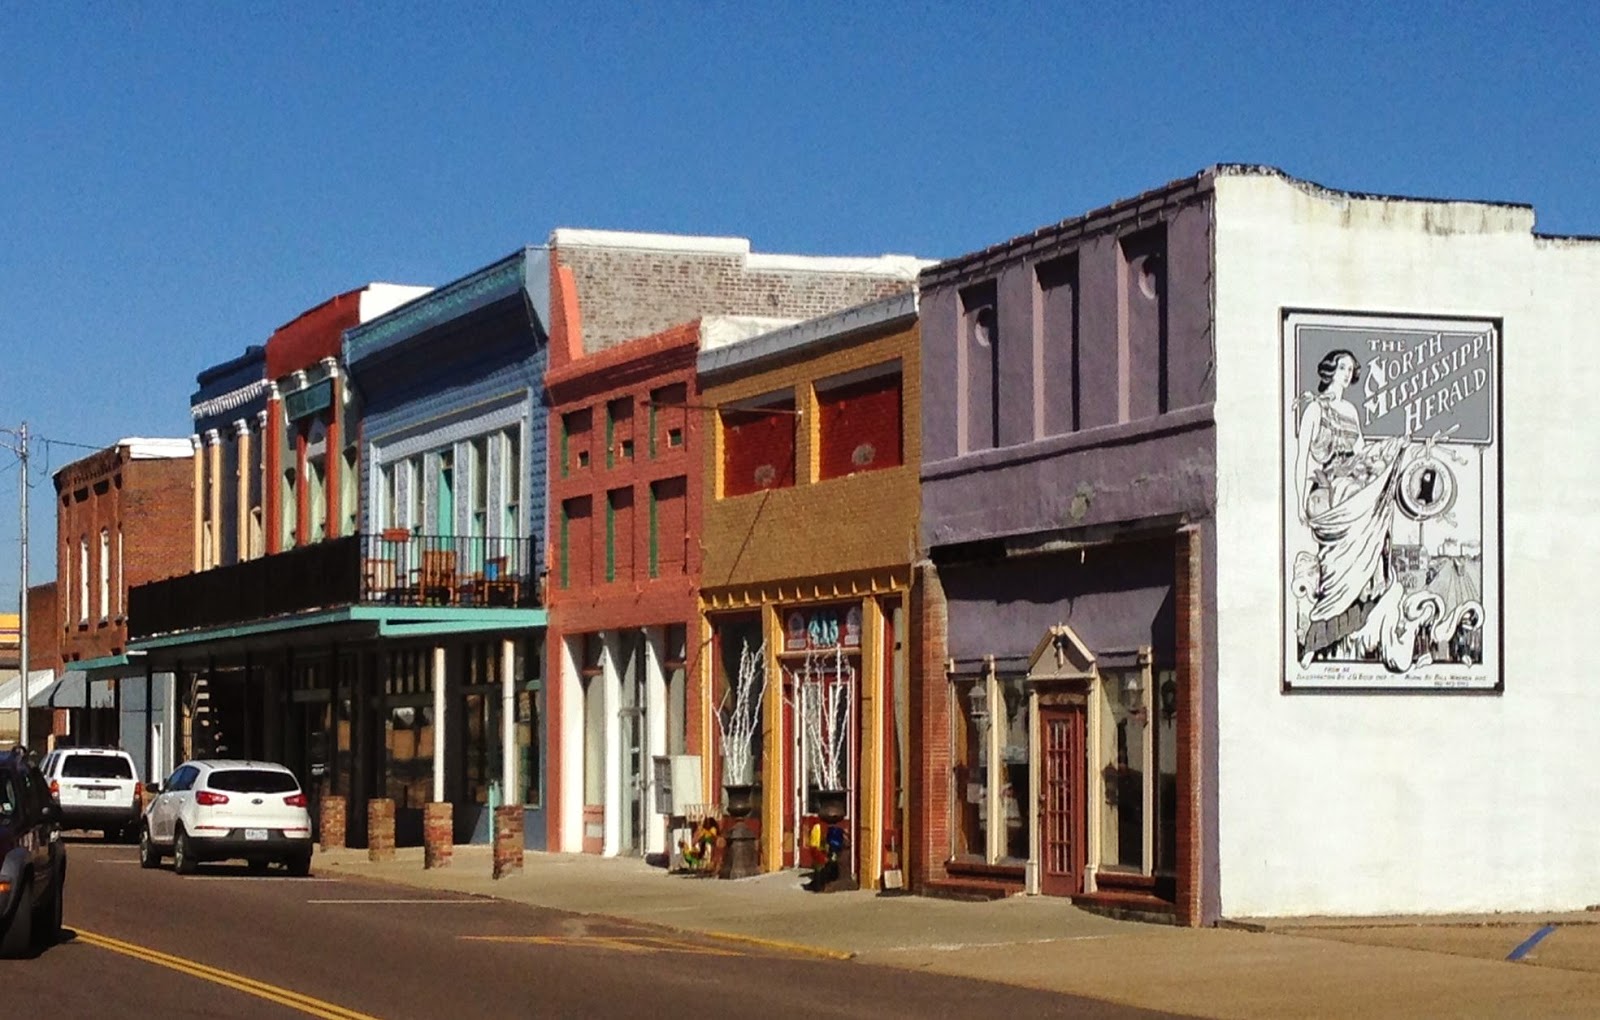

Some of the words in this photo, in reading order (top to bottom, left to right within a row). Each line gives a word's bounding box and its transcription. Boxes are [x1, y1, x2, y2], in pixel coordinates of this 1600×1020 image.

[1363, 330, 1492, 425] MISSISSIPPI
[1364, 332, 1443, 398] NORTH
[1367, 339, 1405, 351] THE
[1405, 368, 1487, 435] HERALD
